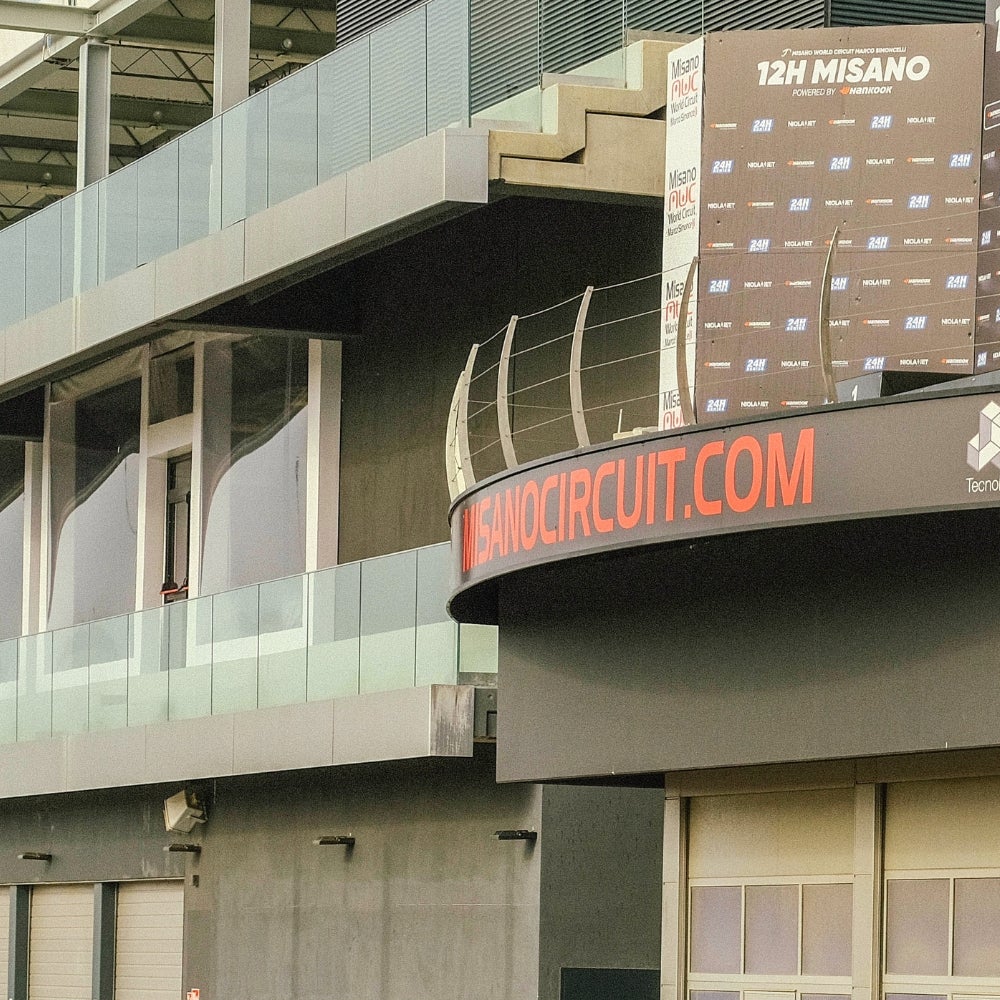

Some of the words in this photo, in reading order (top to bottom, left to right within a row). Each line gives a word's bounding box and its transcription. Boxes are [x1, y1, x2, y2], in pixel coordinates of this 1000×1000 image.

[671, 55, 700, 80] Misano
[757, 59, 807, 86] 12H
[811, 55, 930, 84] MISANO
[792, 88, 826, 97] POWERED
[826, 88, 836, 96] BY
[669, 167, 697, 191] Misano
[665, 280, 693, 301] Misa
[663, 391, 681, 411] Misa
[462, 428, 814, 572] MISANOCIRCUIT.COM
